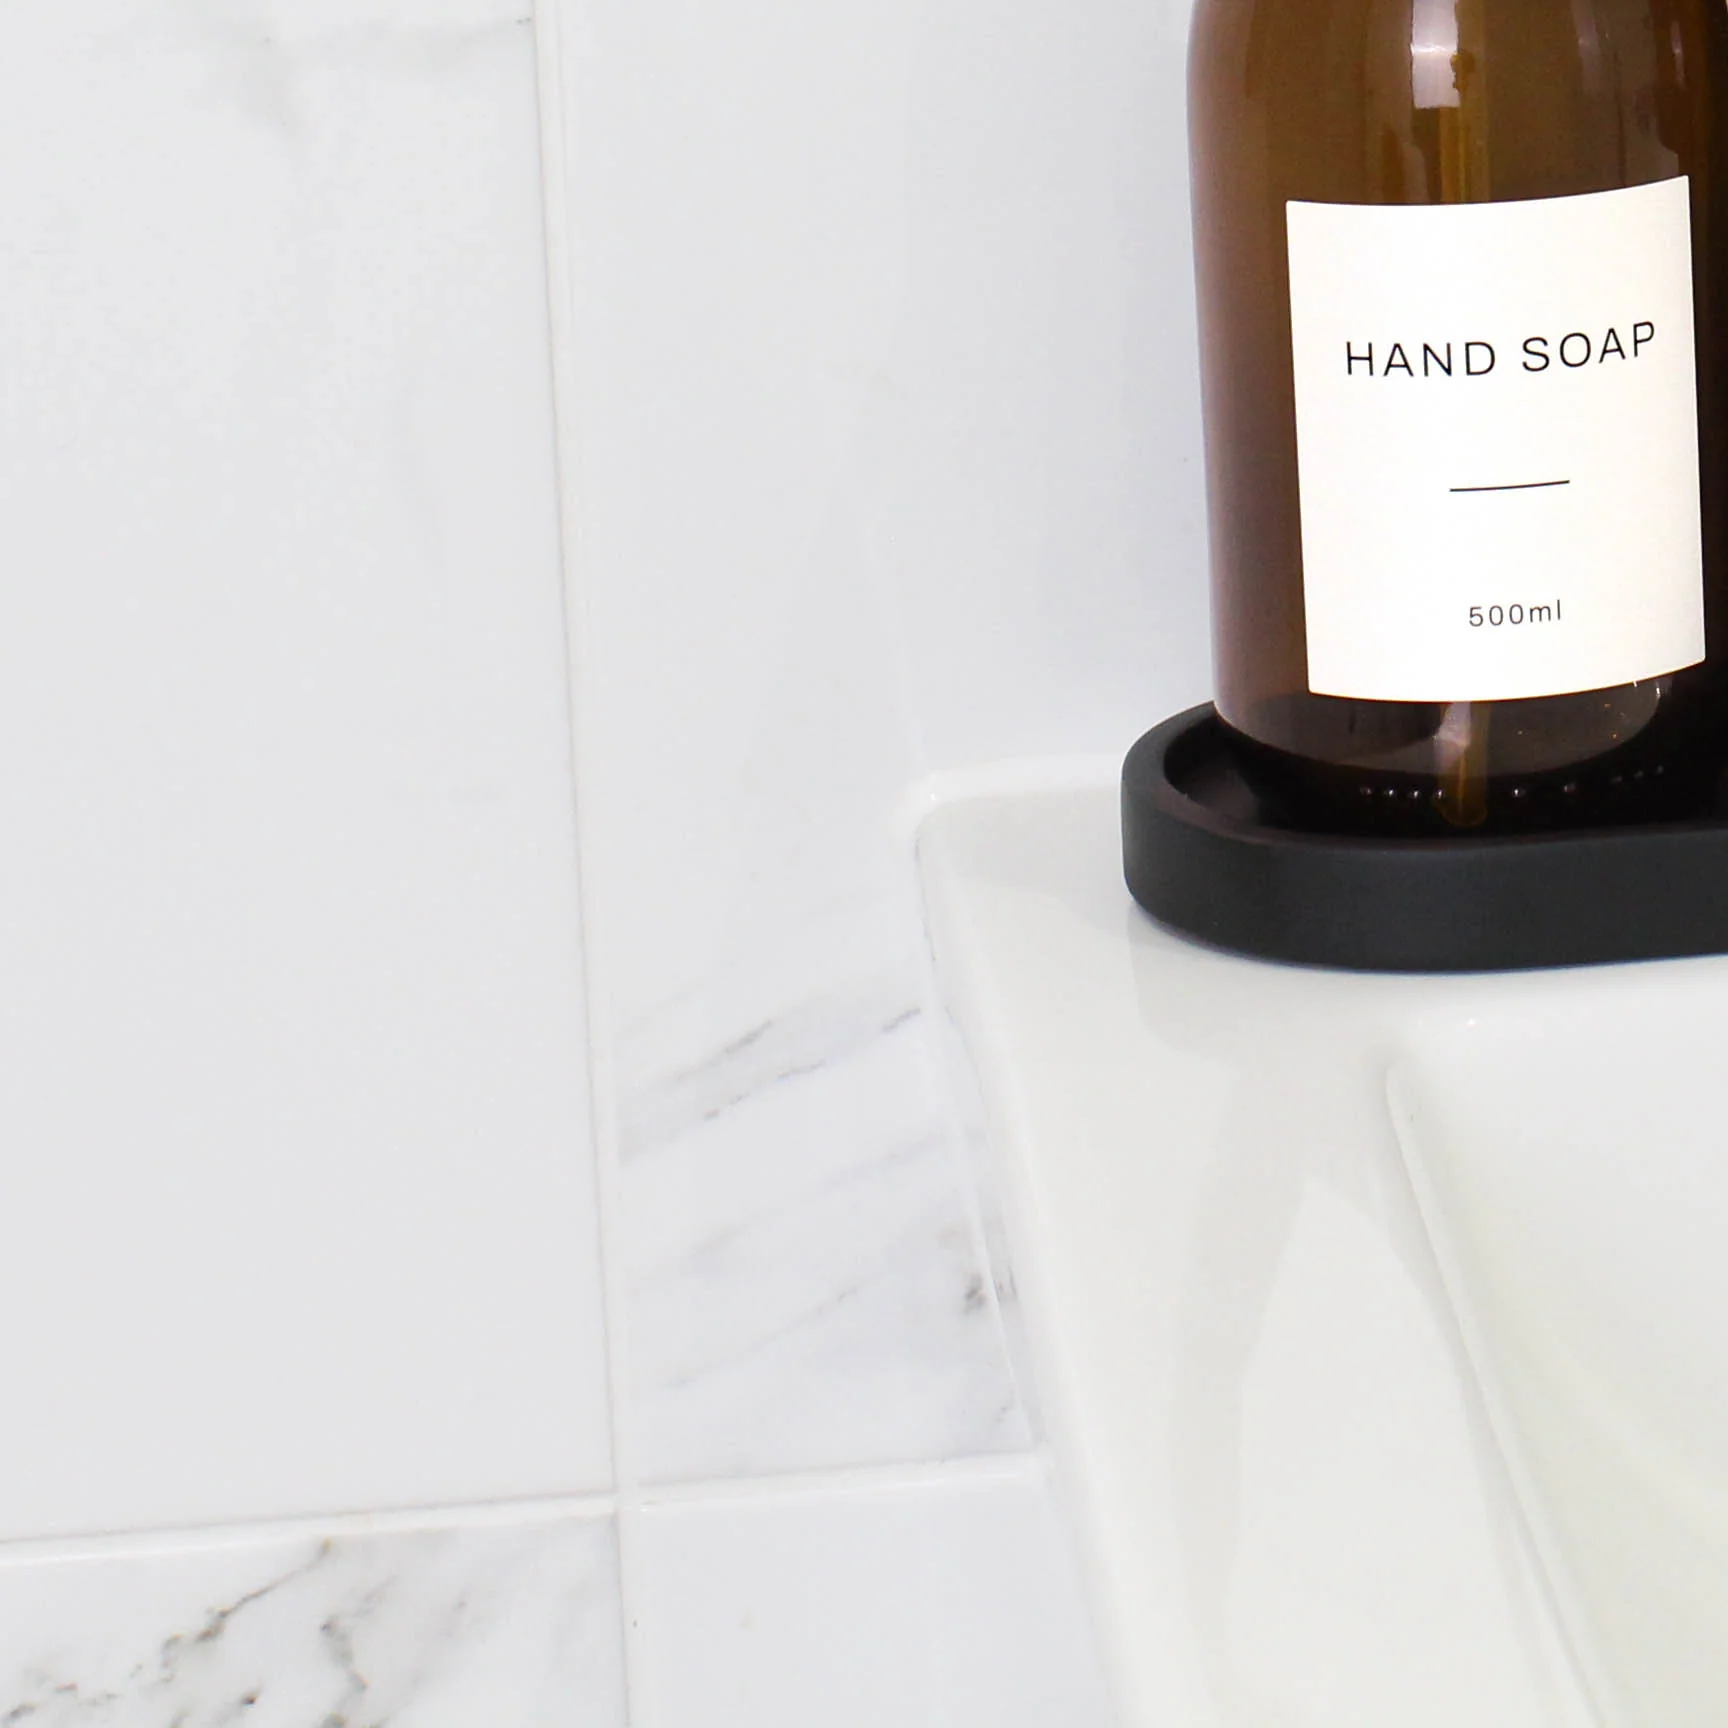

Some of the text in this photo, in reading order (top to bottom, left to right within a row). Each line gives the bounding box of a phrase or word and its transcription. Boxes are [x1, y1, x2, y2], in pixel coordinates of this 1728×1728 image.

[1346, 321, 1656, 378] HAND SOAP
[1468, 598, 1562, 628] 500ml
